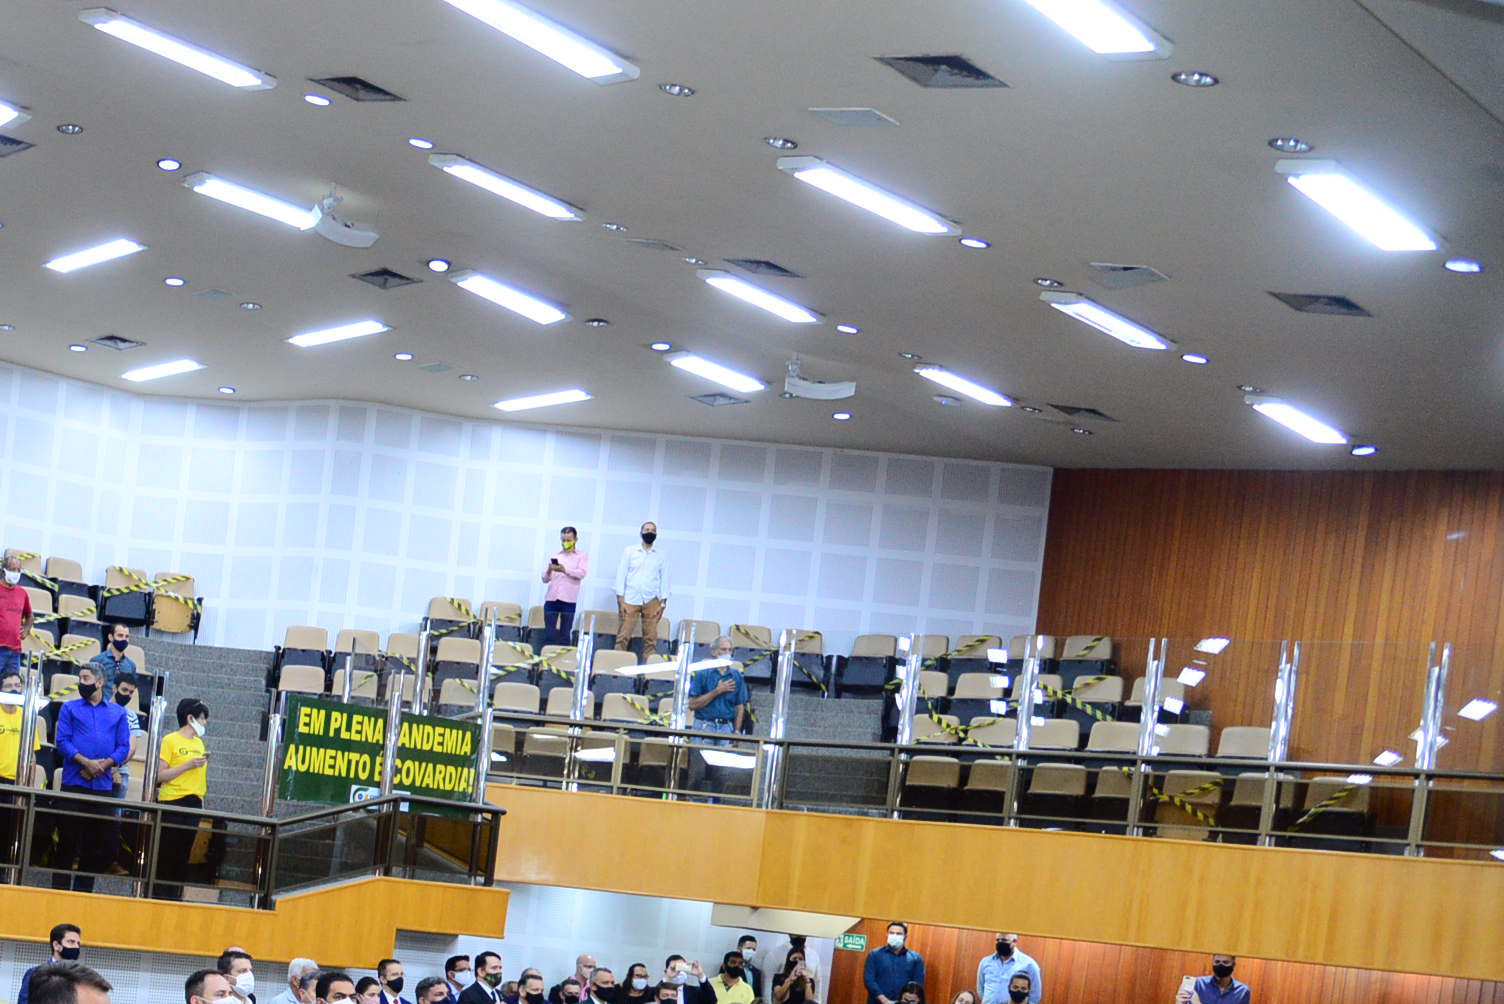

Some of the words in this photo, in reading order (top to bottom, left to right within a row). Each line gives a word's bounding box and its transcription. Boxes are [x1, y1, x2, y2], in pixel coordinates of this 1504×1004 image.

[298, 706, 326, 735] EM
[329, 711, 384, 744] PLENA
[397, 721, 472, 756] ANDEMIA
[283, 744, 371, 780] AUMENTO
[392, 758, 476, 794] COVARDIA!
